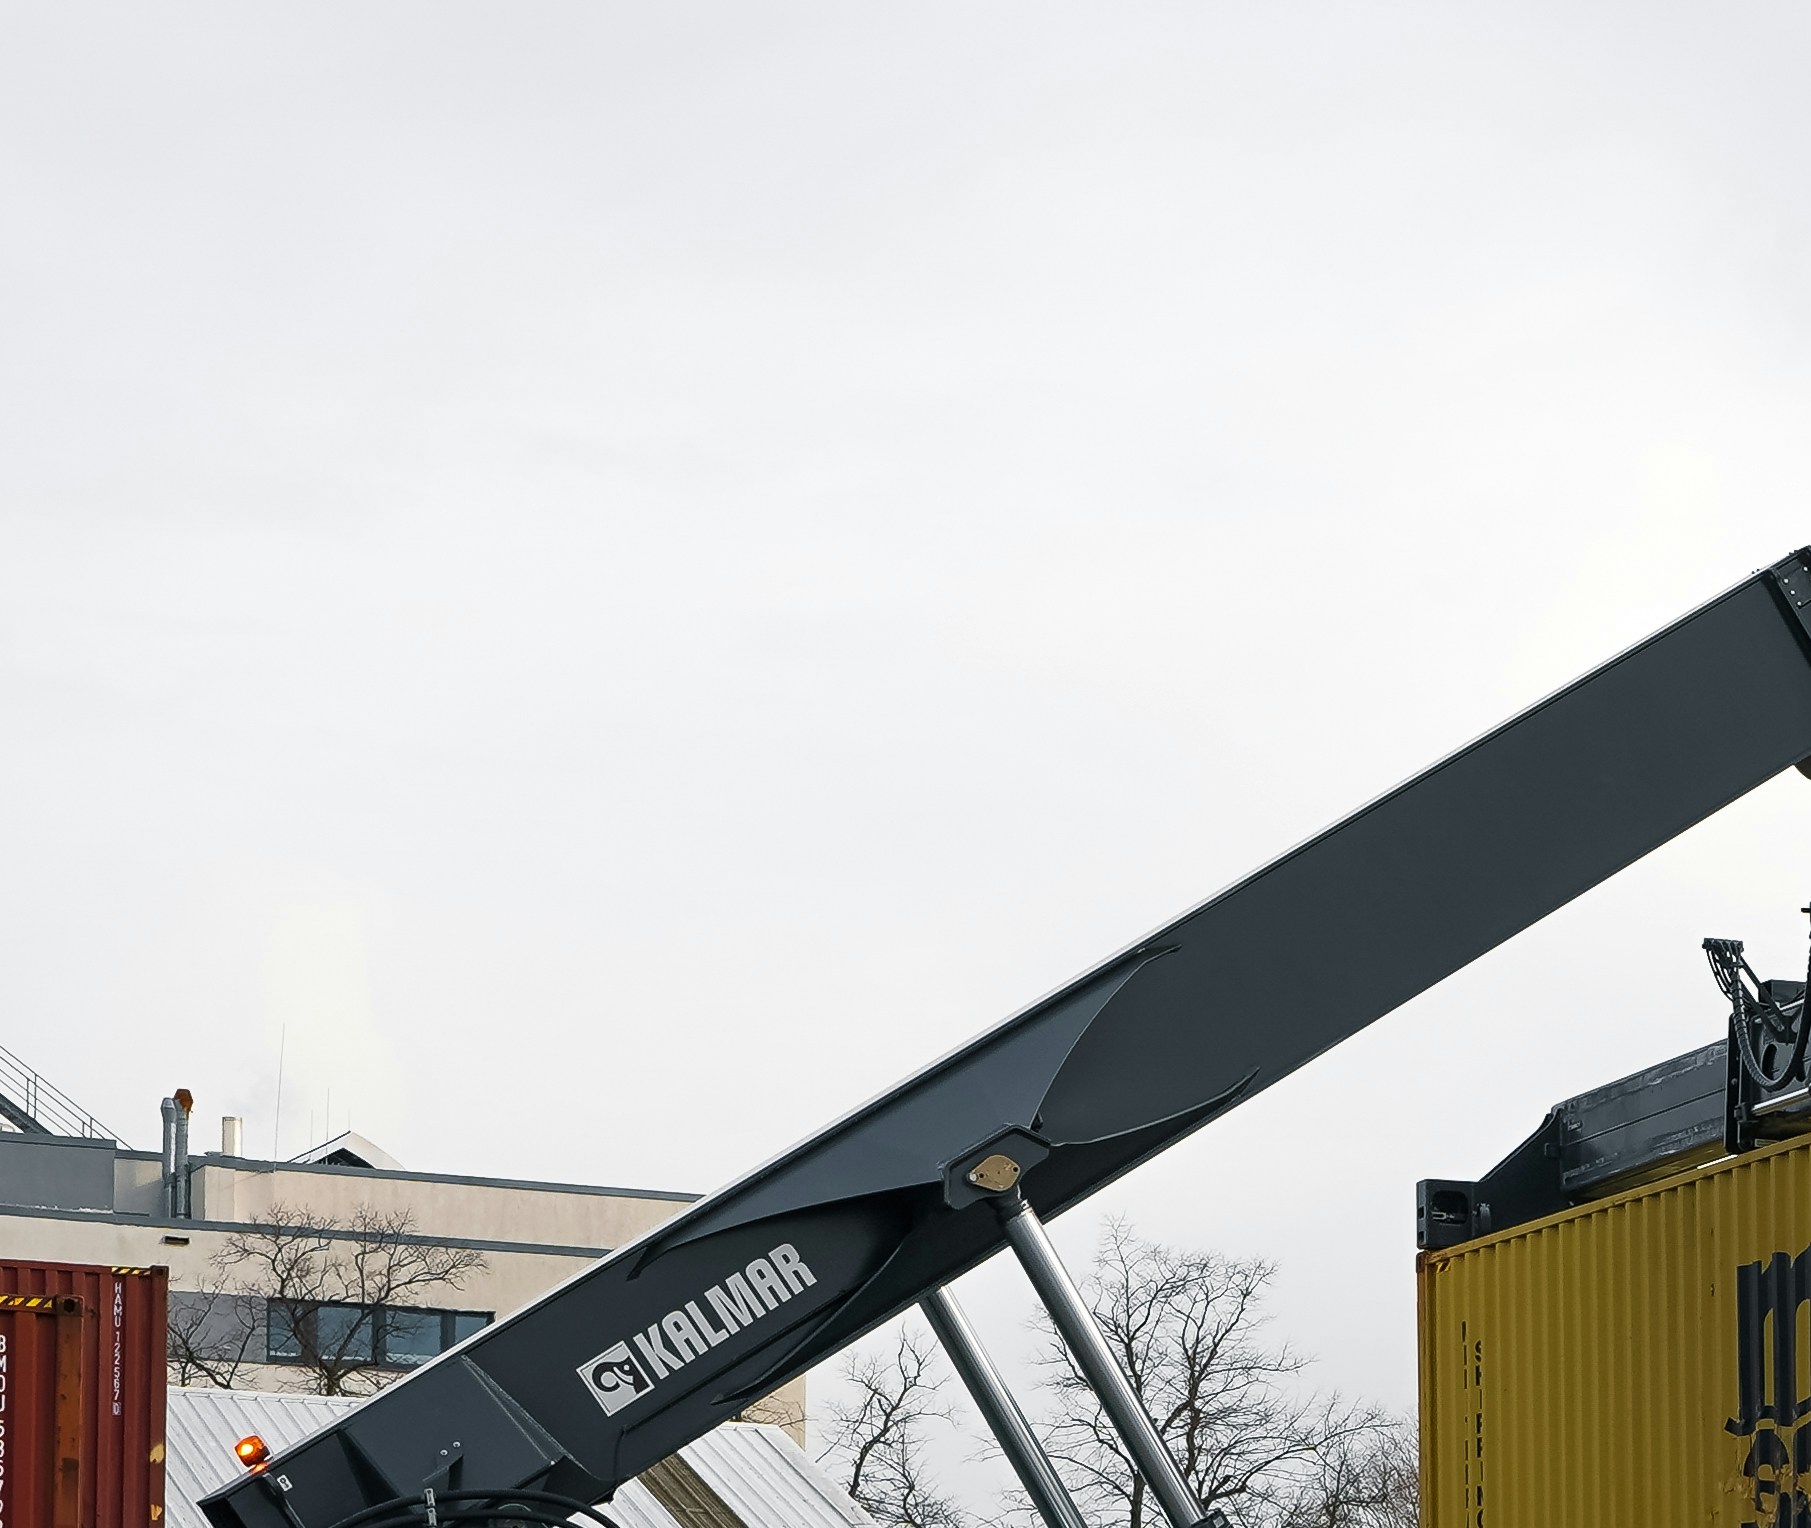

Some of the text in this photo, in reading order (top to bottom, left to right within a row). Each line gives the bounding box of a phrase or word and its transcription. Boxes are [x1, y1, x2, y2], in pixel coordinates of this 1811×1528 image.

[113, 1281, 122, 1328] HAMU
[632, 1243, 818, 1380] KALMAR
[112, 1331, 121, 1401] 122567
